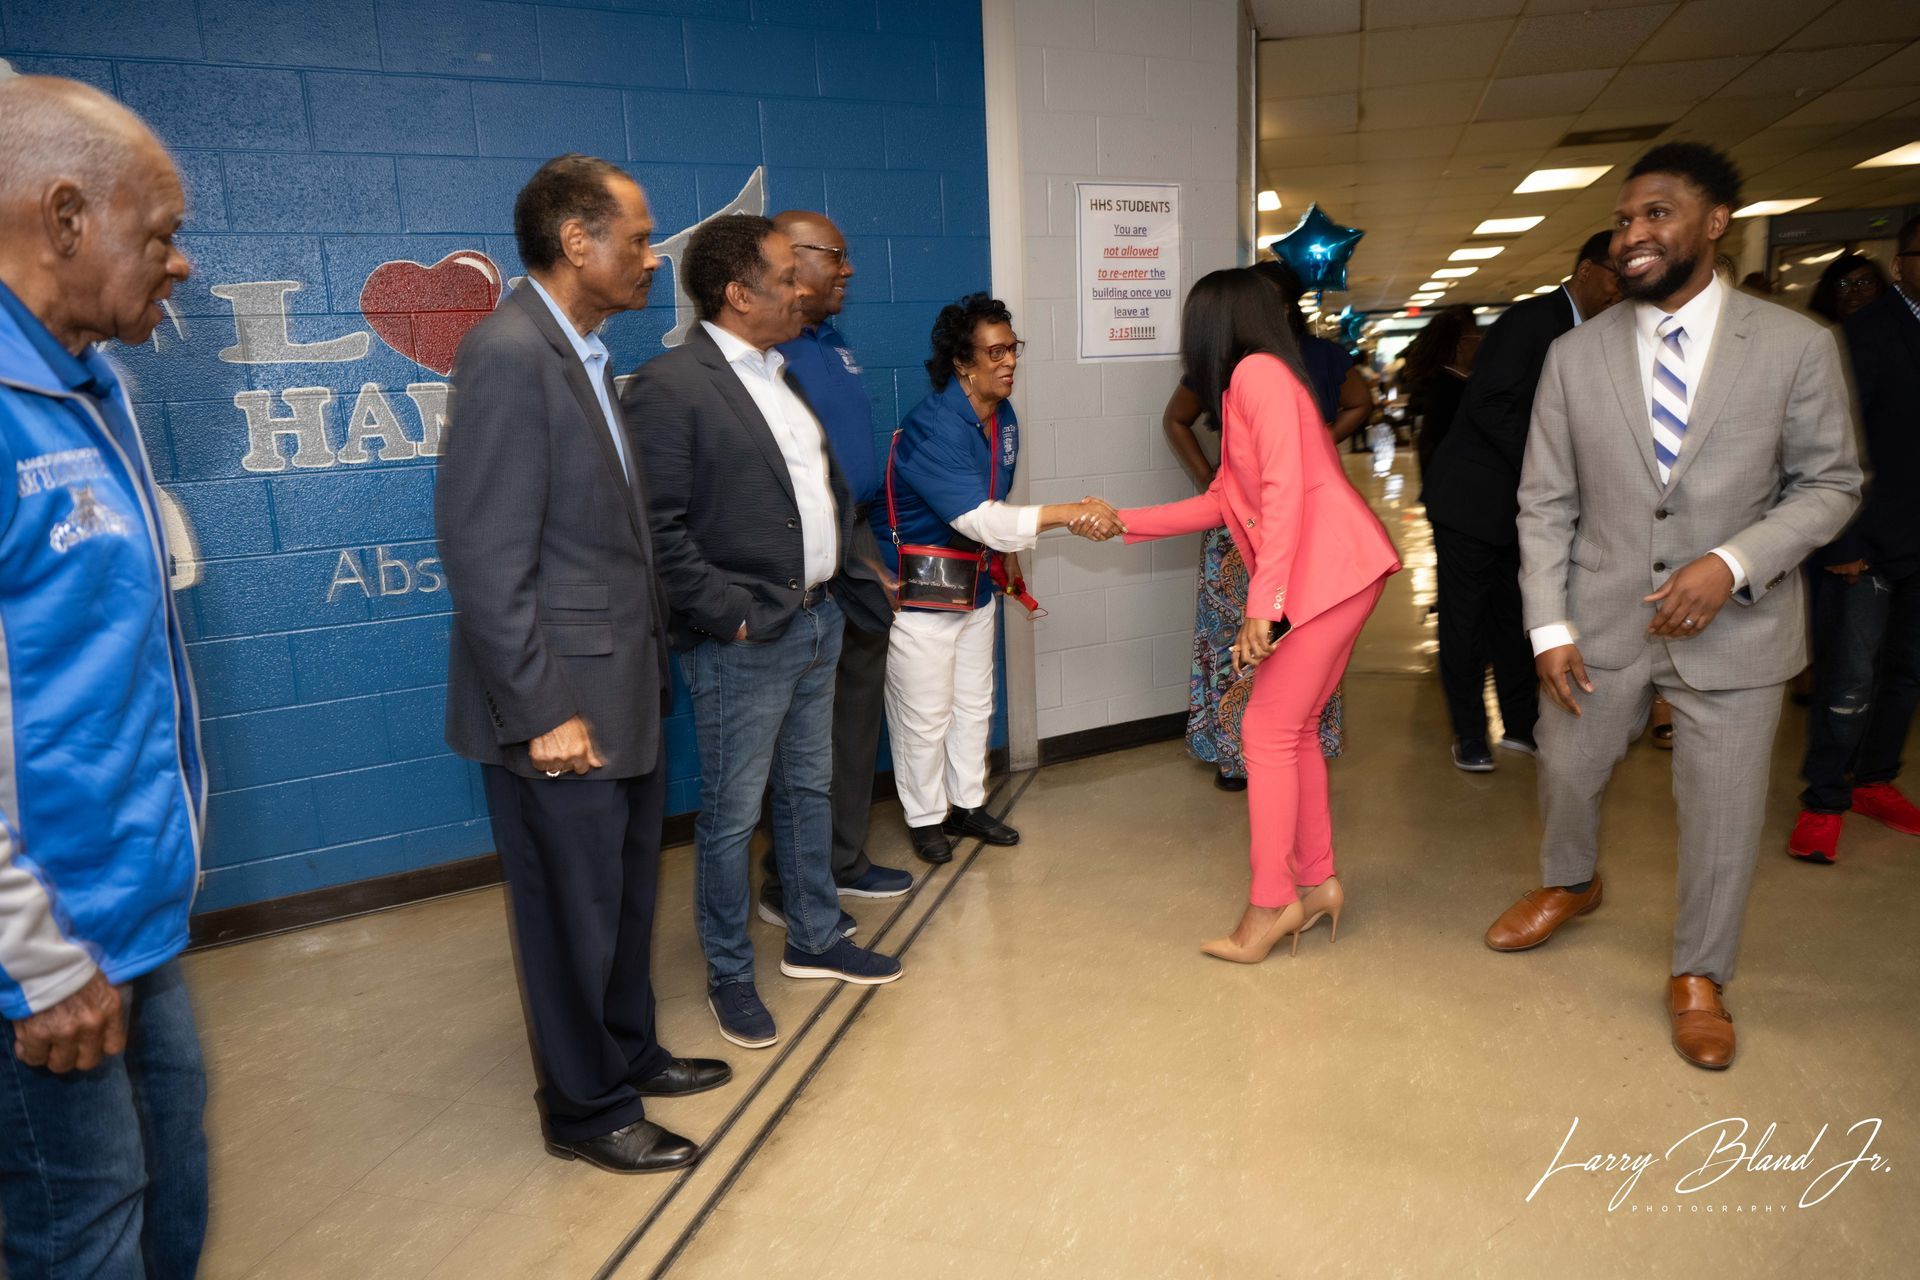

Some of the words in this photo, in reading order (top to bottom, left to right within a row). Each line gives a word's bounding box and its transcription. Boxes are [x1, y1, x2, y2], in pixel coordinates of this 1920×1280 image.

[1090, 199, 1113, 212] HHS
[1116, 199, 1171, 213] STUDENTS
[1114, 224, 1131, 235] You
[1133, 226, 1147, 235] are
[1104, 246, 1120, 257] not
[1121, 245, 1159, 257] allowed
[1098, 268, 1107, 279] to
[1109, 268, 1148, 279] re-enter
[1150, 268, 1166, 279] the
[1092, 287, 1128, 299] building
[1130, 289, 1152, 298] once
[1154, 288, 1171, 299] you
[1114, 306, 1138, 317] leave
[1140, 307, 1150, 317] at
